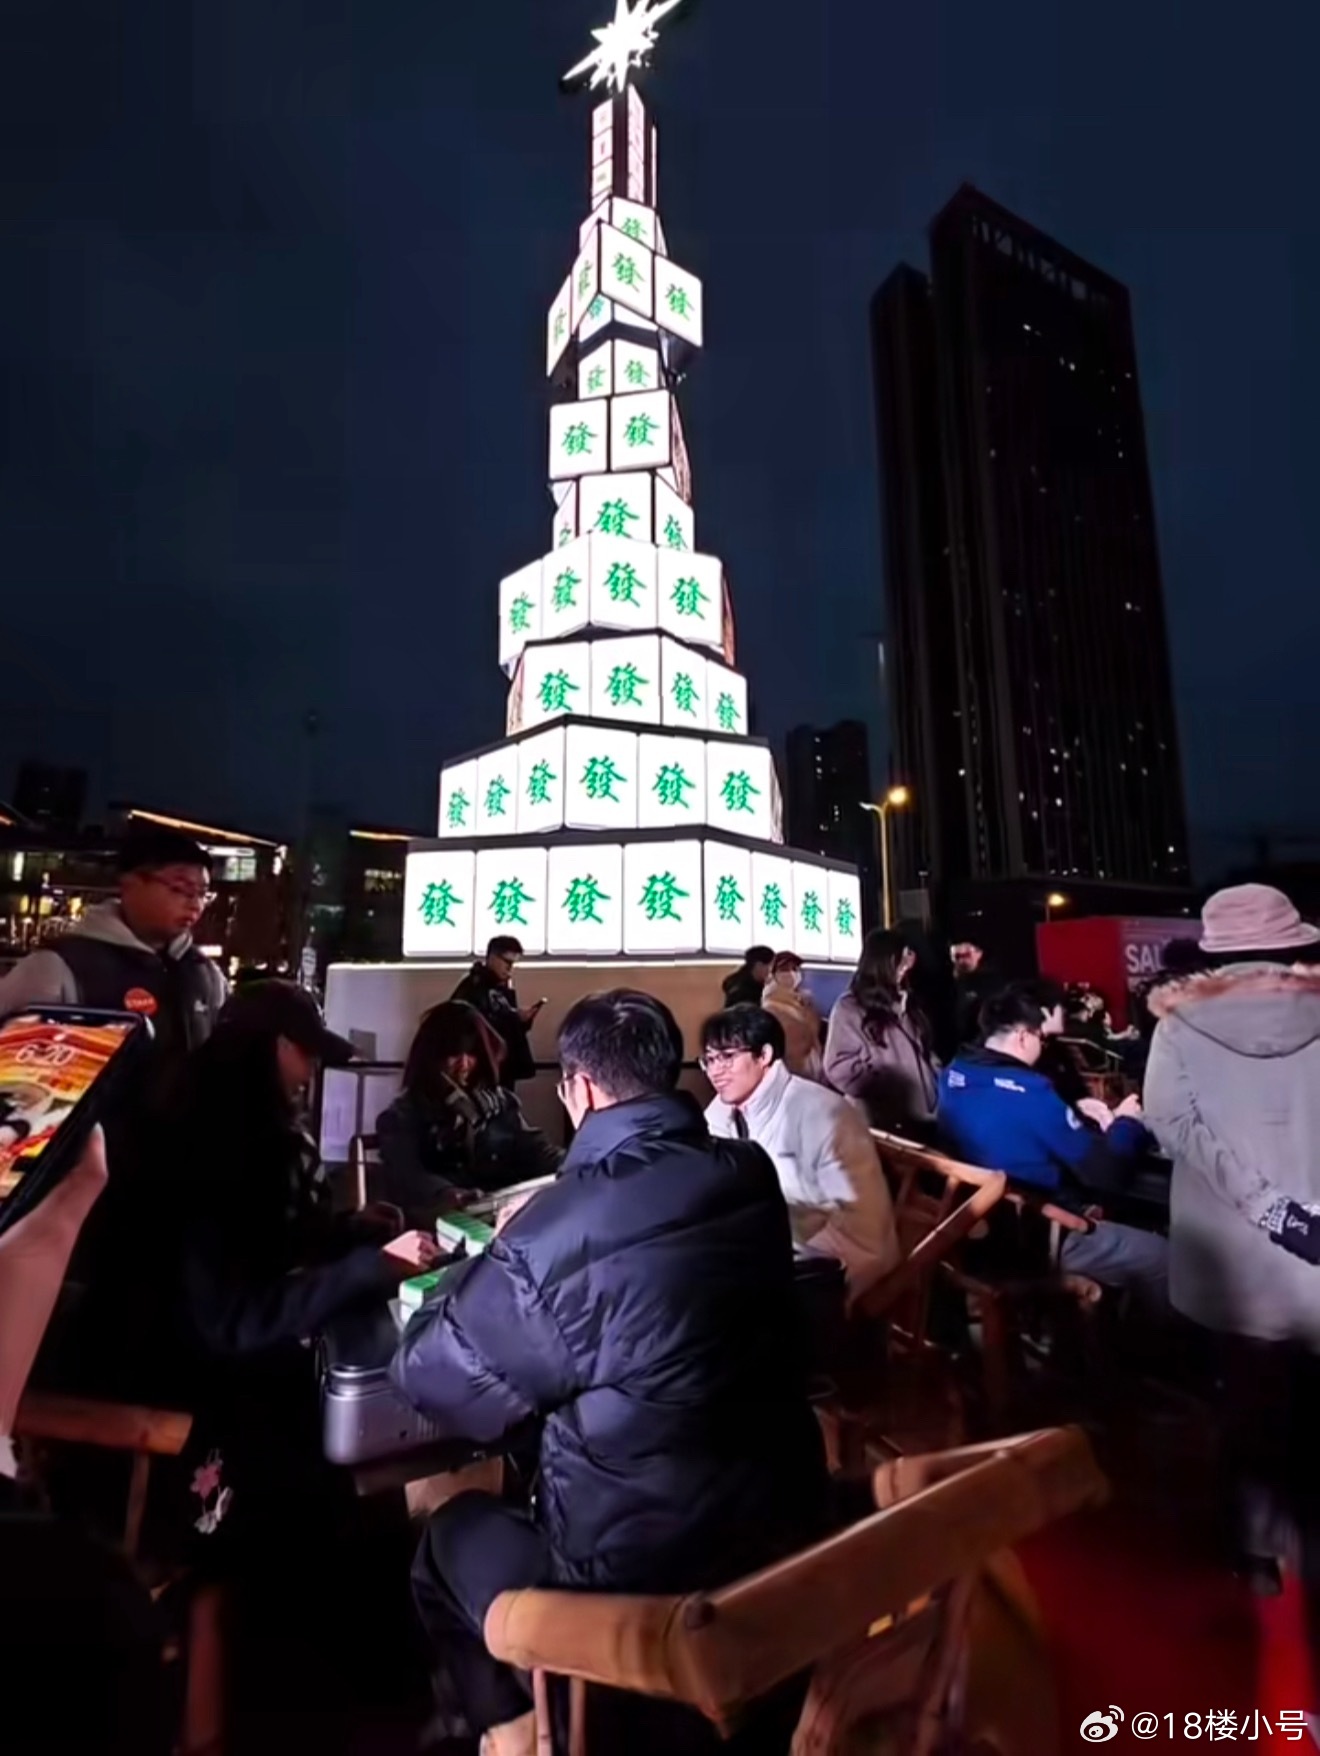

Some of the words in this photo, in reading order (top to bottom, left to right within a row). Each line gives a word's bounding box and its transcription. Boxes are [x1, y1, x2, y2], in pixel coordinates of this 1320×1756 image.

[561, 421, 597, 456] 發
[623, 412, 660, 447] 發
[603, 561, 647, 608] 發
[670, 576, 711, 620] 發
[536, 669, 581, 713] 發
[604, 662, 650, 708] 發
[671, 670, 701, 717] 發
[484, 774, 512, 817] 發
[527, 758, 558, 806] 發
[579, 755, 628, 804] 發
[652, 761, 697, 811] 發
[719, 768, 763, 815] 發
[417, 878, 465, 928] 發
[488, 877, 536, 927] 發
[560, 874, 612, 925] 發
[637, 869, 692, 923] 發
[713, 874, 746, 925] 發
[760, 881, 787, 931] 發
